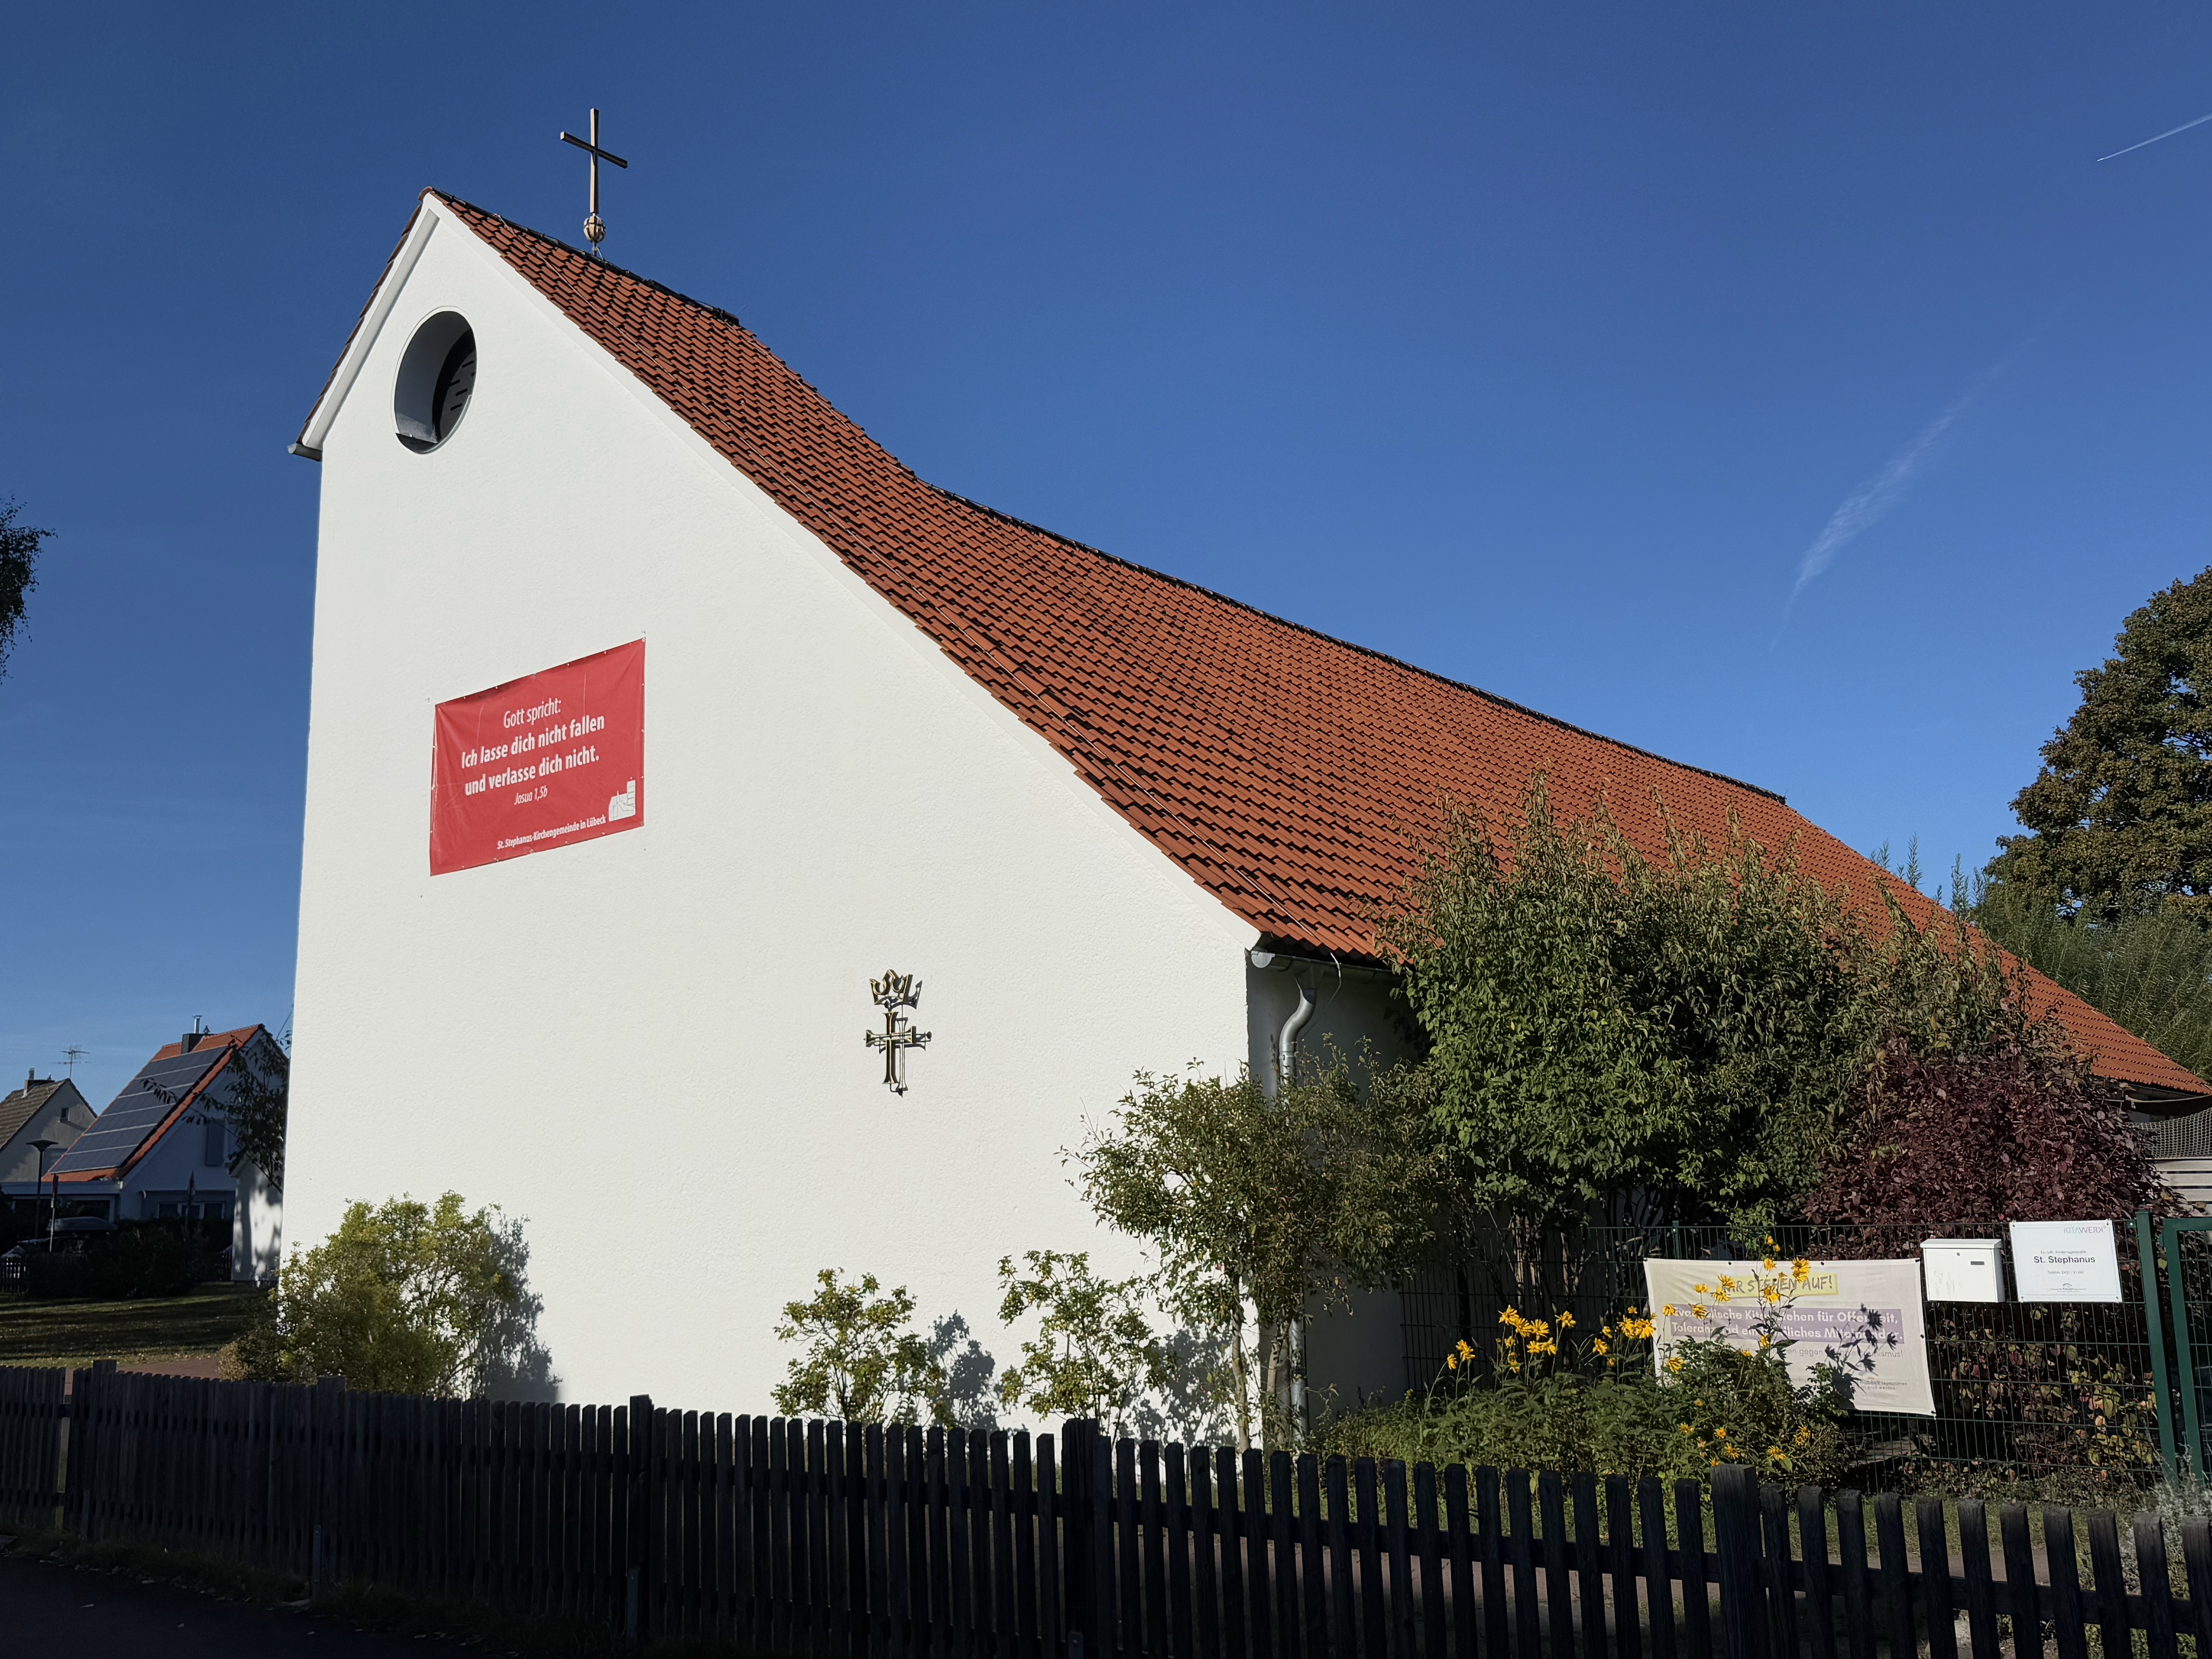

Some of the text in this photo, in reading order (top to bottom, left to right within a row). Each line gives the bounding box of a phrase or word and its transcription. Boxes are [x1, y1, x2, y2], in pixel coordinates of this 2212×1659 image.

[504, 698, 562, 728] Gott spricht:
[462, 714, 605, 769] Ich lasse dich nicht fallen
[465, 745, 599, 796] und verlasse dich nicht.
[514, 785, 548, 805] Josua 1,5b
[505, 821, 580, 848] Stephanus-Kirchengemeinde
[580, 820, 586, 830] in
[586, 814, 606, 828] Lübeck
[2048, 1255, 2095, 1264] Stephanus
[1802, 1274, 1832, 1291] AUF!
[1817, 1310, 1834, 1322] für
[1837, 1311, 1898, 1324] Offeeit,
